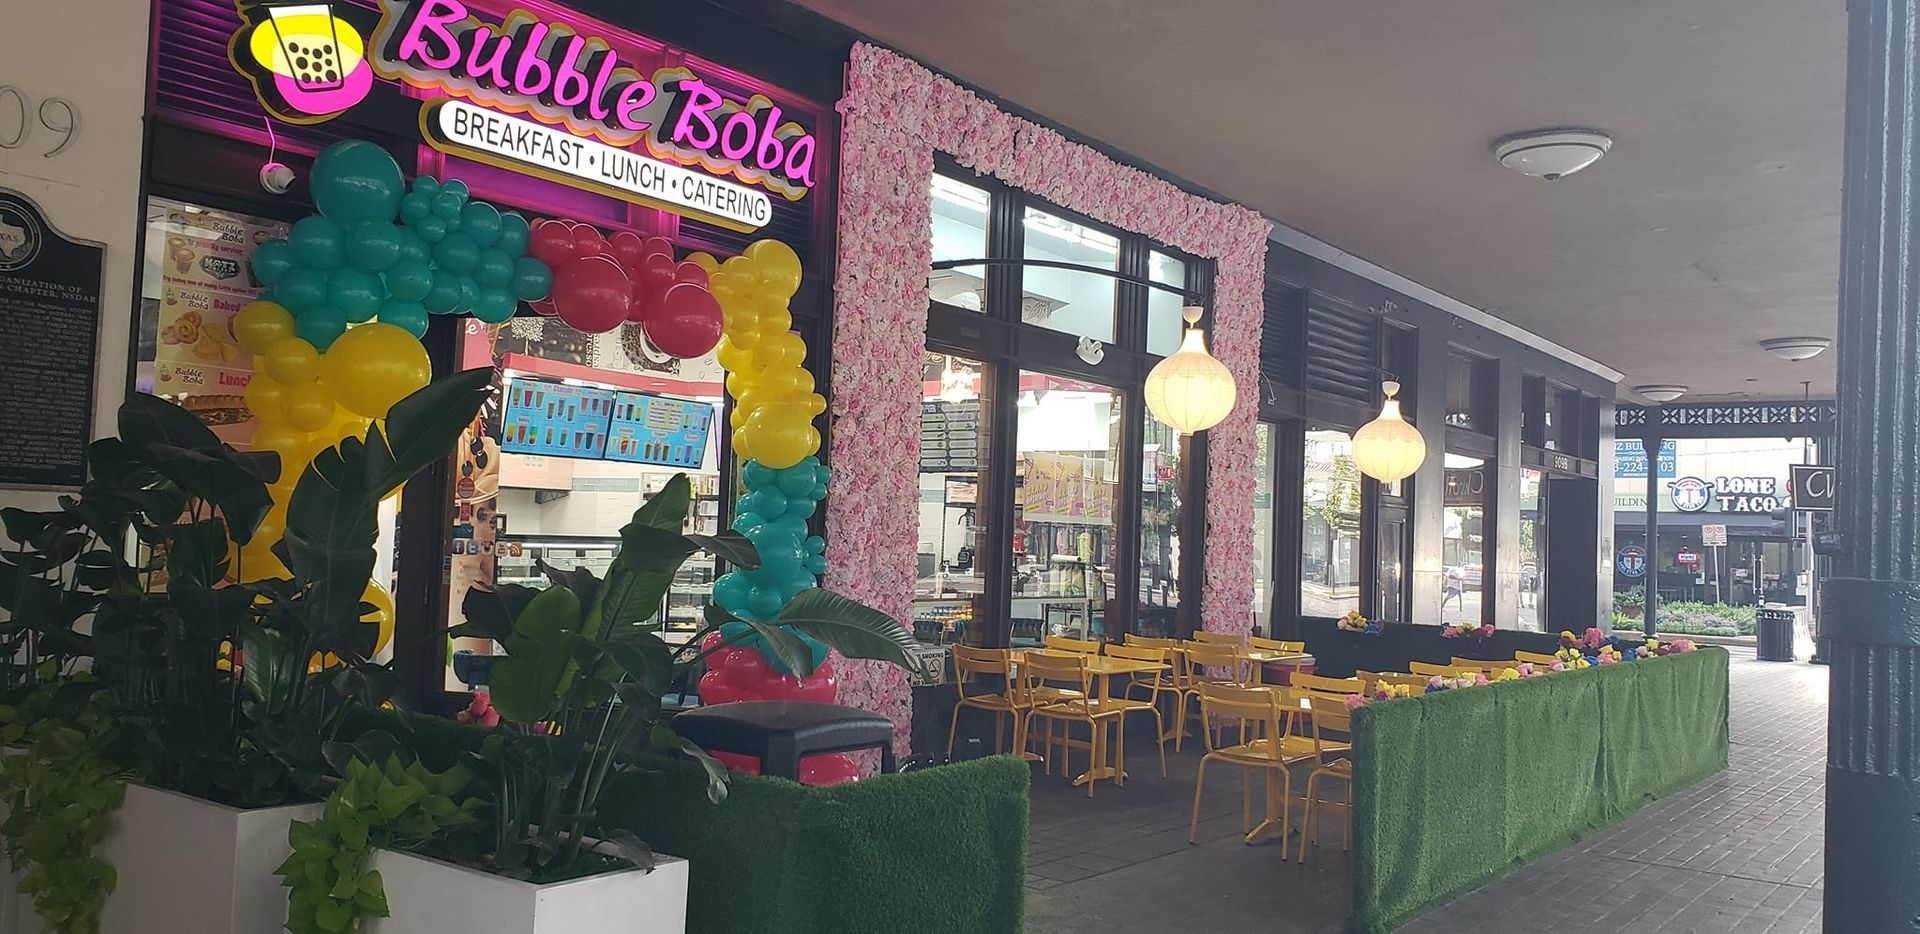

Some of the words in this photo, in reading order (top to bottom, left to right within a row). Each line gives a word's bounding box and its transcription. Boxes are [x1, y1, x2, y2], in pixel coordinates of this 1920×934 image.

[399, 0, 656, 131] Bubble
[674, 79, 815, 187] Boba
[454, 107, 584, 169] BREAKFAST
[601, 151, 666, 193] LUNCH
[682, 176, 766, 221] CATERING
[212, 221, 243, 236] Bubble
[1716, 477, 1775, 495] LONE
[1716, 495, 1778, 512] TACO
